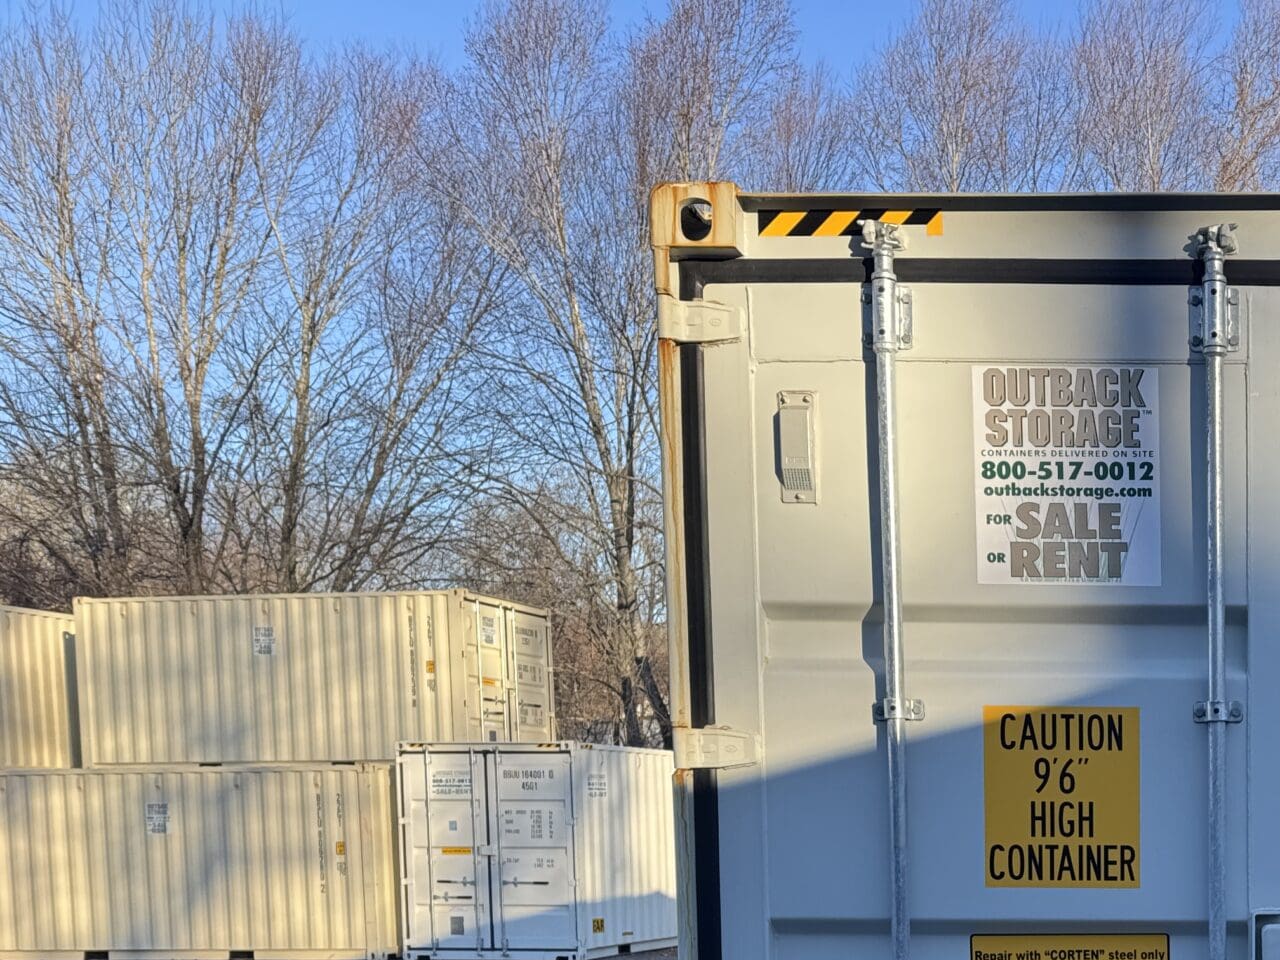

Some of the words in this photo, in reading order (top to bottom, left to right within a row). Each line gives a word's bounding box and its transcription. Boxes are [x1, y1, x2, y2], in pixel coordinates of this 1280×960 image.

[983, 368, 1146, 407] OUTBACK
[985, 409, 1142, 448] STORAGE
[981, 461, 1154, 481] 800-517-0012
[1051, 450, 1108, 458] DELIVERED
[1113, 450, 1128, 458] ON
[1133, 450, 1154, 458] SITE
[984, 483, 1153, 499] outbackstorage.com
[986, 514, 1012, 525] FOR
[1016, 502, 1122, 539] SALE
[987, 552, 1006, 563] OR
[1010, 542, 1128, 578] RENT
[1000, 713, 1123, 751] CAUTION
[1030, 801, 1094, 838] HIGH
[989, 844, 1136, 882] CONTAINER
[1015, 950, 1041, 960] with
[1108, 949, 1137, 960] steel
